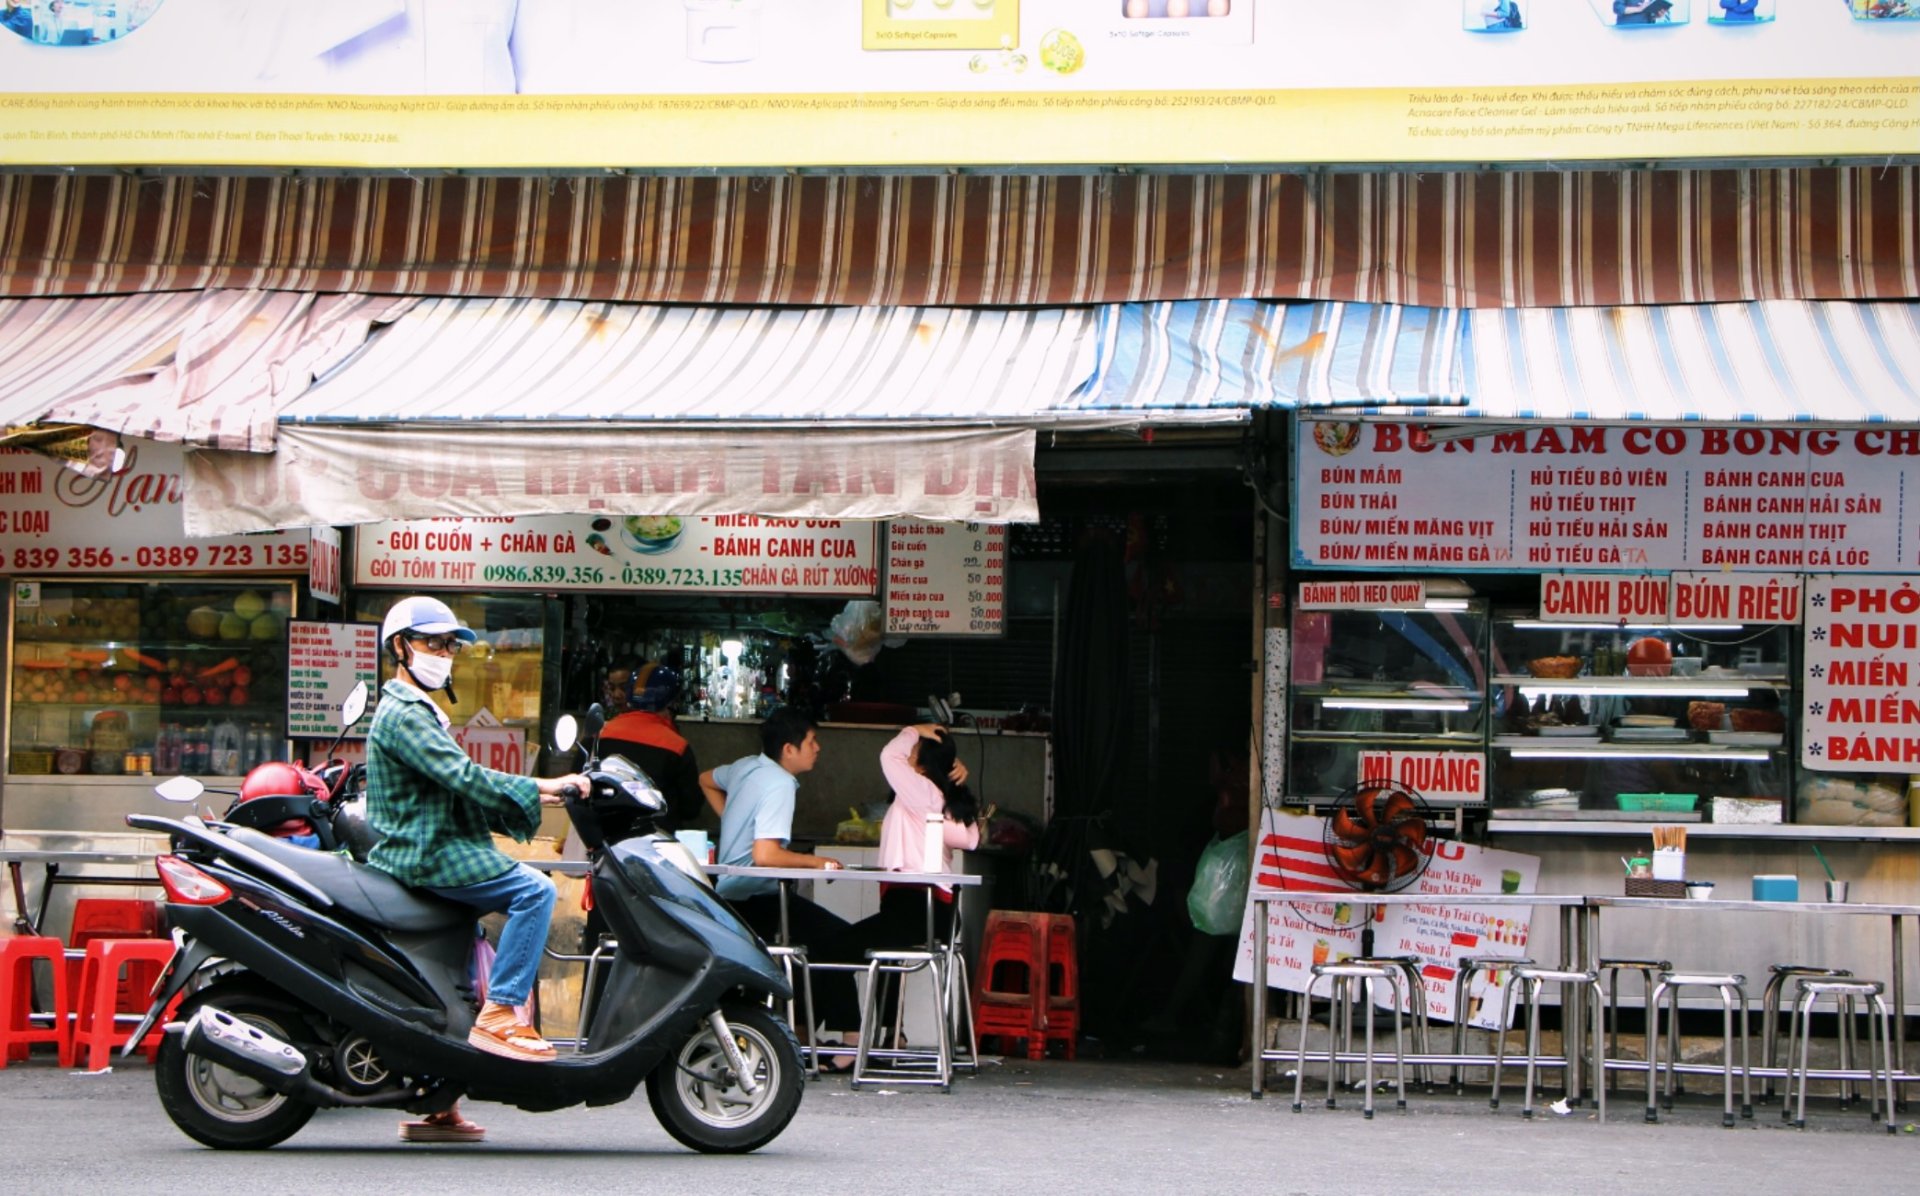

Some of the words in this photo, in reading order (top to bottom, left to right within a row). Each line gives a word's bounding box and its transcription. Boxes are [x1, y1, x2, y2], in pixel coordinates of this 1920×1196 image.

[895, 30, 922, 41] Softgel
[350, 101, 398, 111] Nourishing
[400, 101, 425, 111] Night
[850, 98, 897, 109] Whitening
[899, 98, 929, 107] Serum
[1407, 108, 1452, 117] Acnacare
[1454, 107, 1476, 117] Face
[1477, 106, 1519, 116] Cleanser
[1656, 121, 1685, 133] Mega
[1686, 120, 1743, 131] Lifesciences
[22, 466, 42, 494] MÌ
[1321, 467, 1355, 484] BÚN
[1360, 464, 1402, 484] MẮM
[1531, 465, 1552, 485] HỦ
[1558, 465, 1596, 485] TIẾU
[1600, 468, 1621, 486] BÒ
[1628, 470, 1668, 487] VIÊN
[1704, 469, 1752, 487] BÁNH
[1757, 472, 1806, 488] CANH
[1811, 472, 1845, 487] CUA
[1321, 492, 1355, 509] BÚN
[1360, 493, 1397, 509] THÁI
[1530, 491, 1552, 511] HỦ
[1557, 491, 1595, 511] TIẾU
[1600, 497, 1636, 515] THỊT
[1704, 494, 1753, 513] BÁNH
[1757, 498, 1804, 513] CANH
[1809, 493, 1839, 513] HẢI
[1844, 492, 1881, 513] SẢN
[13, 510, 49, 538] LOẠI
[1320, 518, 1360, 534] BÚN/
[1365, 516, 1409, 535] MIẾN
[1414, 517, 1464, 536] MĂNG
[1469, 521, 1495, 539] VỊT
[1529, 517, 1552, 537] HỦ
[1557, 516, 1595, 537] TIẾU
[1599, 519, 1627, 538] HẢI
[1632, 518, 1668, 538] SẢN
[1703, 520, 1751, 539] BÁNH
[1756, 523, 1805, 539] CANH
[1809, 523, 1847, 542] THỊT
[390, 526, 419, 550] GỎI
[426, 525, 472, 552] CUỐN
[501, 529, 547, 553] CHÂN
[553, 530, 575, 553] GÀ
[714, 533, 760, 556] BÁNH
[767, 538, 814, 558] CANH
[821, 540, 856, 558] CUA
[13, 548, 60, 568] 839
[68, 546, 114, 568] 356
[137, 546, 199, 567] 0389
[208, 545, 253, 566] 723
[264, 544, 308, 565] 135
[1320, 542, 1360, 560] BÚN/
[1365, 541, 1409, 560] MIẾN
[1413, 543, 1463, 561] MĂNG
[1468, 543, 1489, 561] GÀ
[1529, 542, 1550, 563] HỦ
[1556, 542, 1594, 563] TIẾU
[1599, 545, 1620, 563] GÀ
[1702, 546, 1750, 564] BÁNH
[1755, 549, 1804, 565] CANH
[1808, 546, 1832, 565] CÁ
[1836, 547, 1870, 565] LÓC
[370, 552, 396, 578] GỎI
[402, 557, 435, 579] TÔM
[441, 561, 476, 583] THỊT
[483, 564, 603, 584] 0986.839.356
[781, 563, 798, 587] GÀ
[803, 563, 829, 587] RÚT
[1364, 585, 1387, 603] HEO
[1546, 579, 1610, 615] CANH
[1618, 574, 1668, 615] BÚN
[1676, 577, 1730, 618] BÚN
[1738, 579, 1799, 620] RIÊU
[1829, 624, 1917, 648] NUI
[1827, 653, 1908, 686] MIẾN
[1827, 691, 1920, 724] MIẾN
[1827, 731, 1920, 762] BÁNH
[1363, 750, 1392, 790] MÌ
